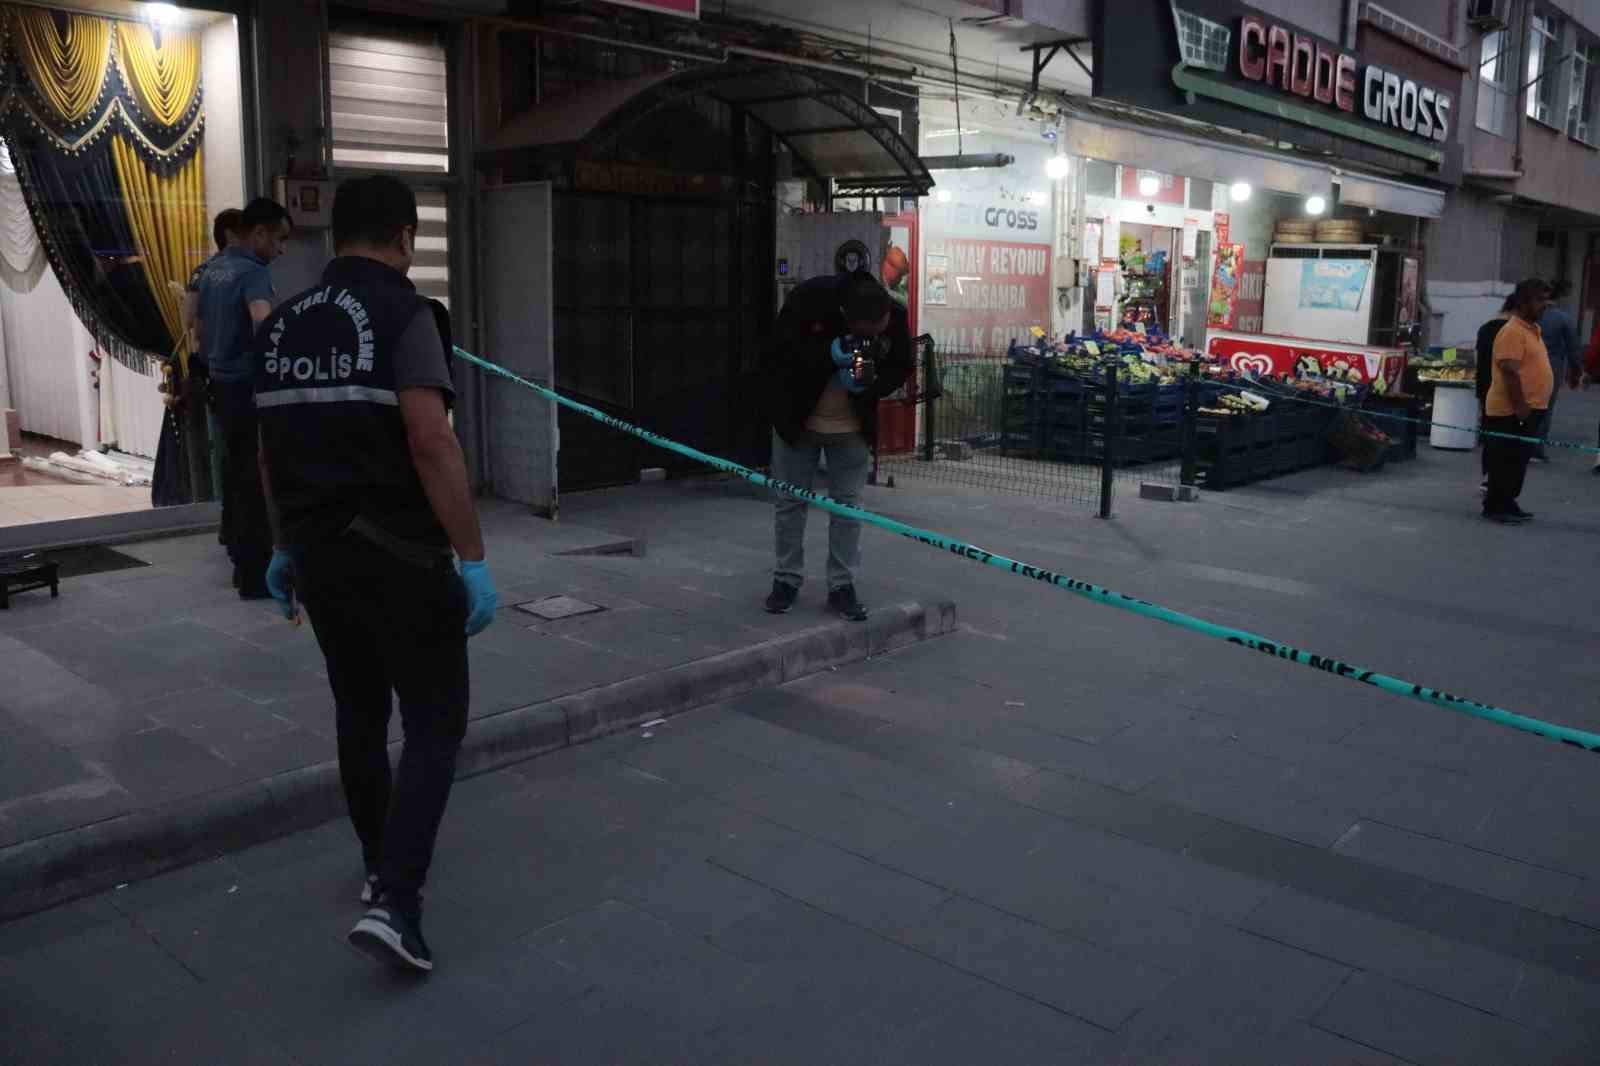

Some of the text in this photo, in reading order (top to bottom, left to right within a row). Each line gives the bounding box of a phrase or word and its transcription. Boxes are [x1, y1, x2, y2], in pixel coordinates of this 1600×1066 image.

[1240, 15, 1451, 142] CADDE GROSS
[264, 317, 287, 374] OLAY
[279, 346, 352, 381] POLİS
